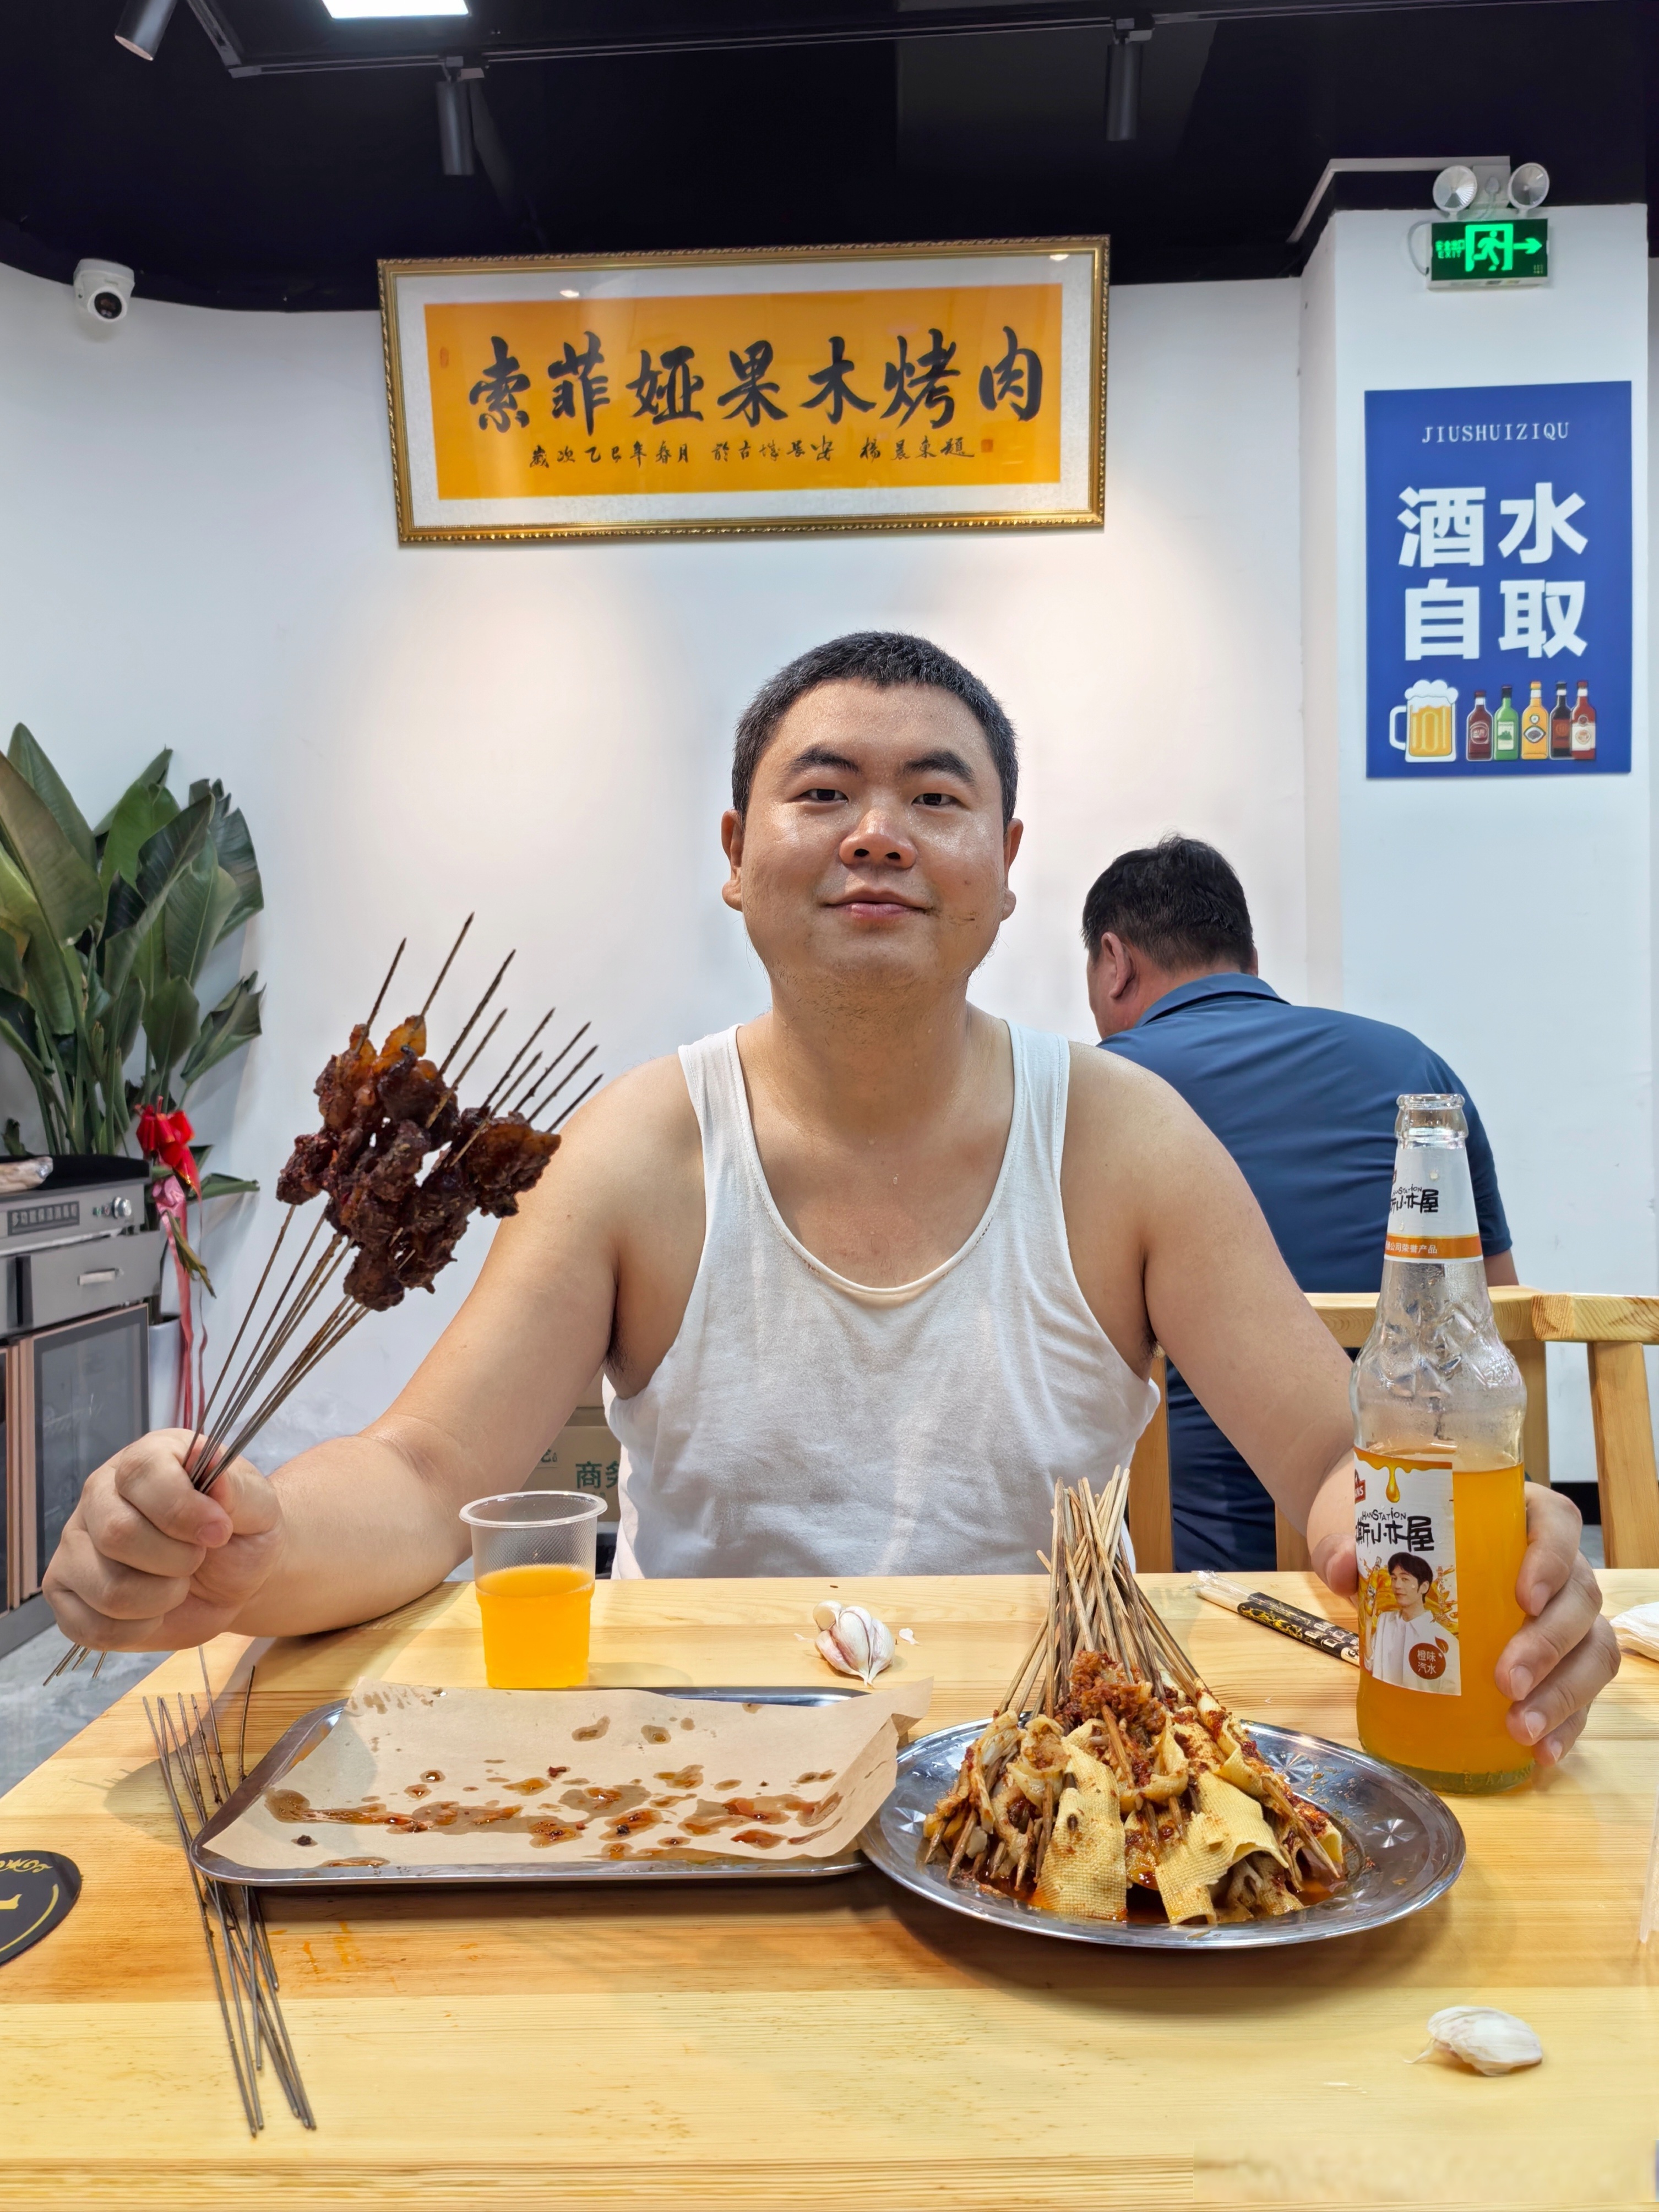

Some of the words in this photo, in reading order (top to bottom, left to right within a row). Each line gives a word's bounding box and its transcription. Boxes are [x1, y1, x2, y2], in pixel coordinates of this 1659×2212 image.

[1435, 239, 1465, 251] 安全出口
[1438, 250, 1462, 259] EXIT
[469, 326, 1045, 435] 索菲娅果木烤肉
[1422, 422, 1569, 443] JIUSHUIZIQU
[1397, 482, 1589, 568] 酒水
[1405, 579, 1588, 661] 自取
[1417, 1649, 1437, 1662] 橙味
[1418, 1661, 1437, 1674] 汽水
